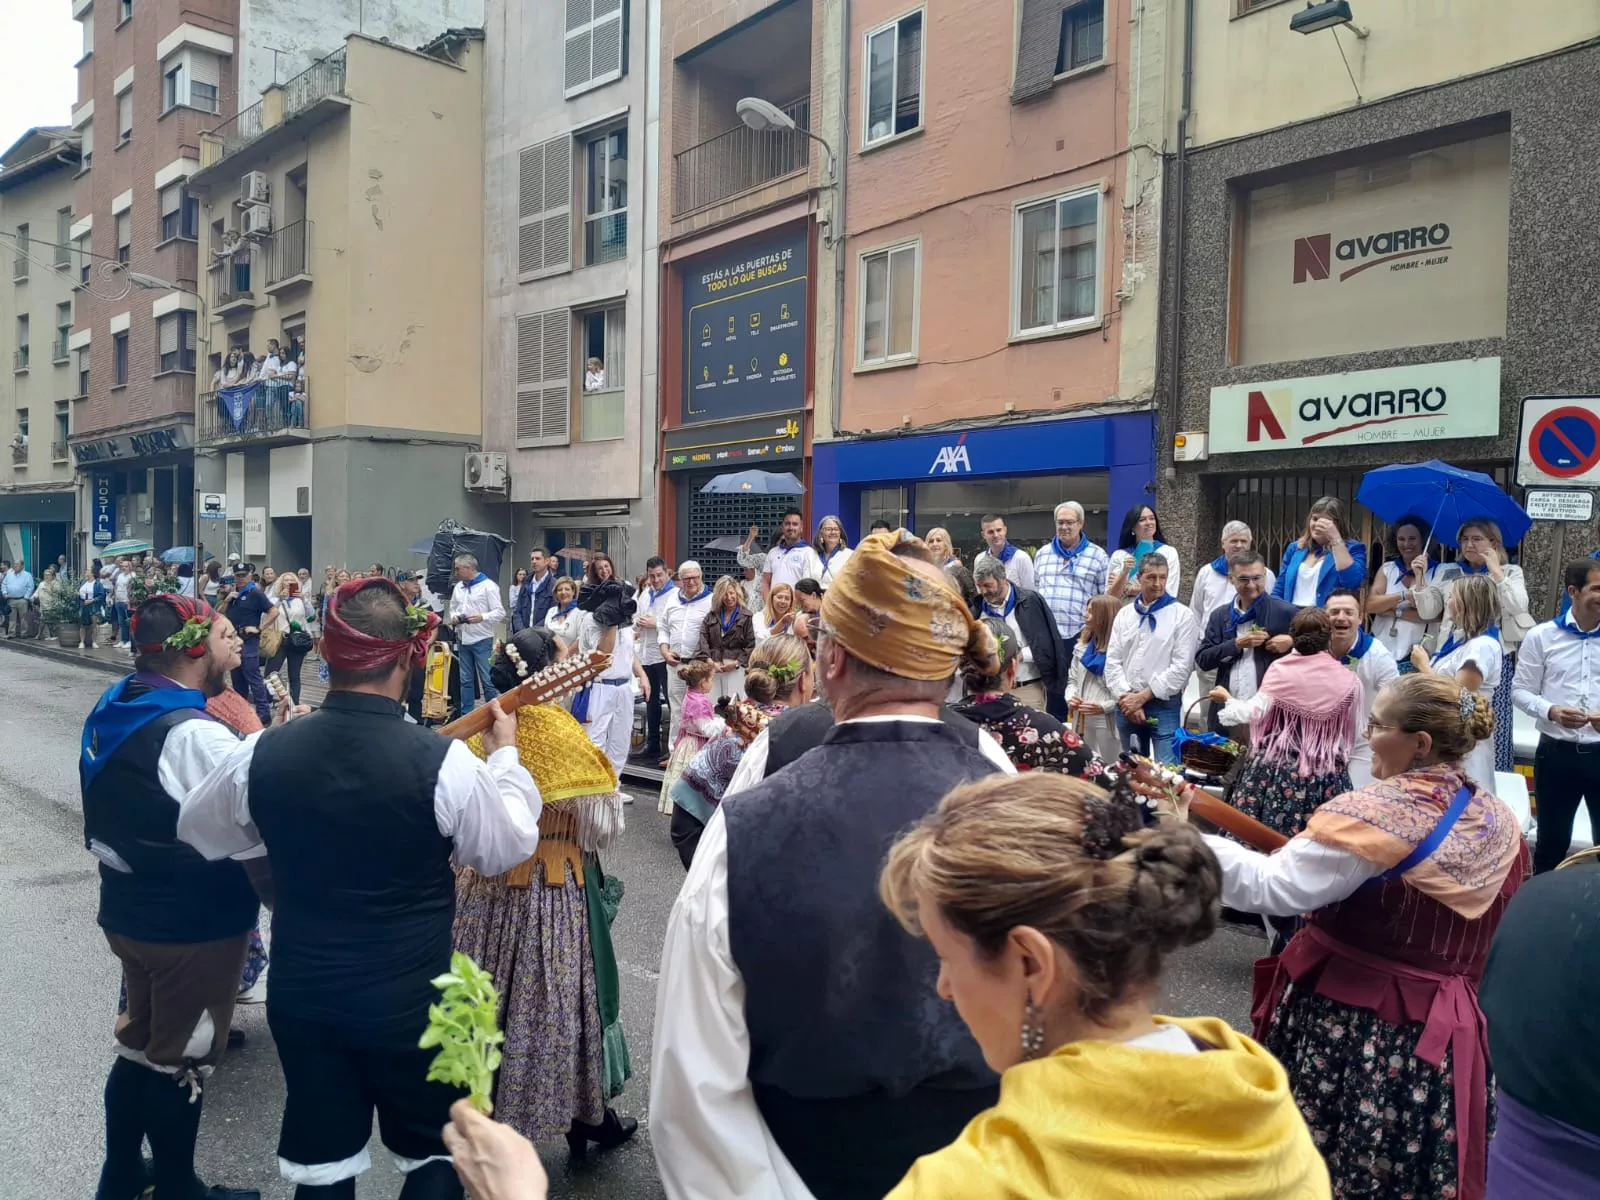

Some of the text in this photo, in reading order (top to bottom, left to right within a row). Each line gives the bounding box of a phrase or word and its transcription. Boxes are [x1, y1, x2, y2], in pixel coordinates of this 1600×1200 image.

[702, 249, 793, 284] ESTÁS A LAS PUERTAS DE
[707, 261, 788, 292] TODO LO QUE BUSCAS
[1390, 261, 1419, 272] HOMBRE
[1425, 256, 1449, 267] MUJER
[1357, 429, 1398, 441] HOMBRE
[1413, 426, 1446, 438] MUJER
[929, 444, 972, 474] AXA
[98, 478, 109, 532] HOSTAL
